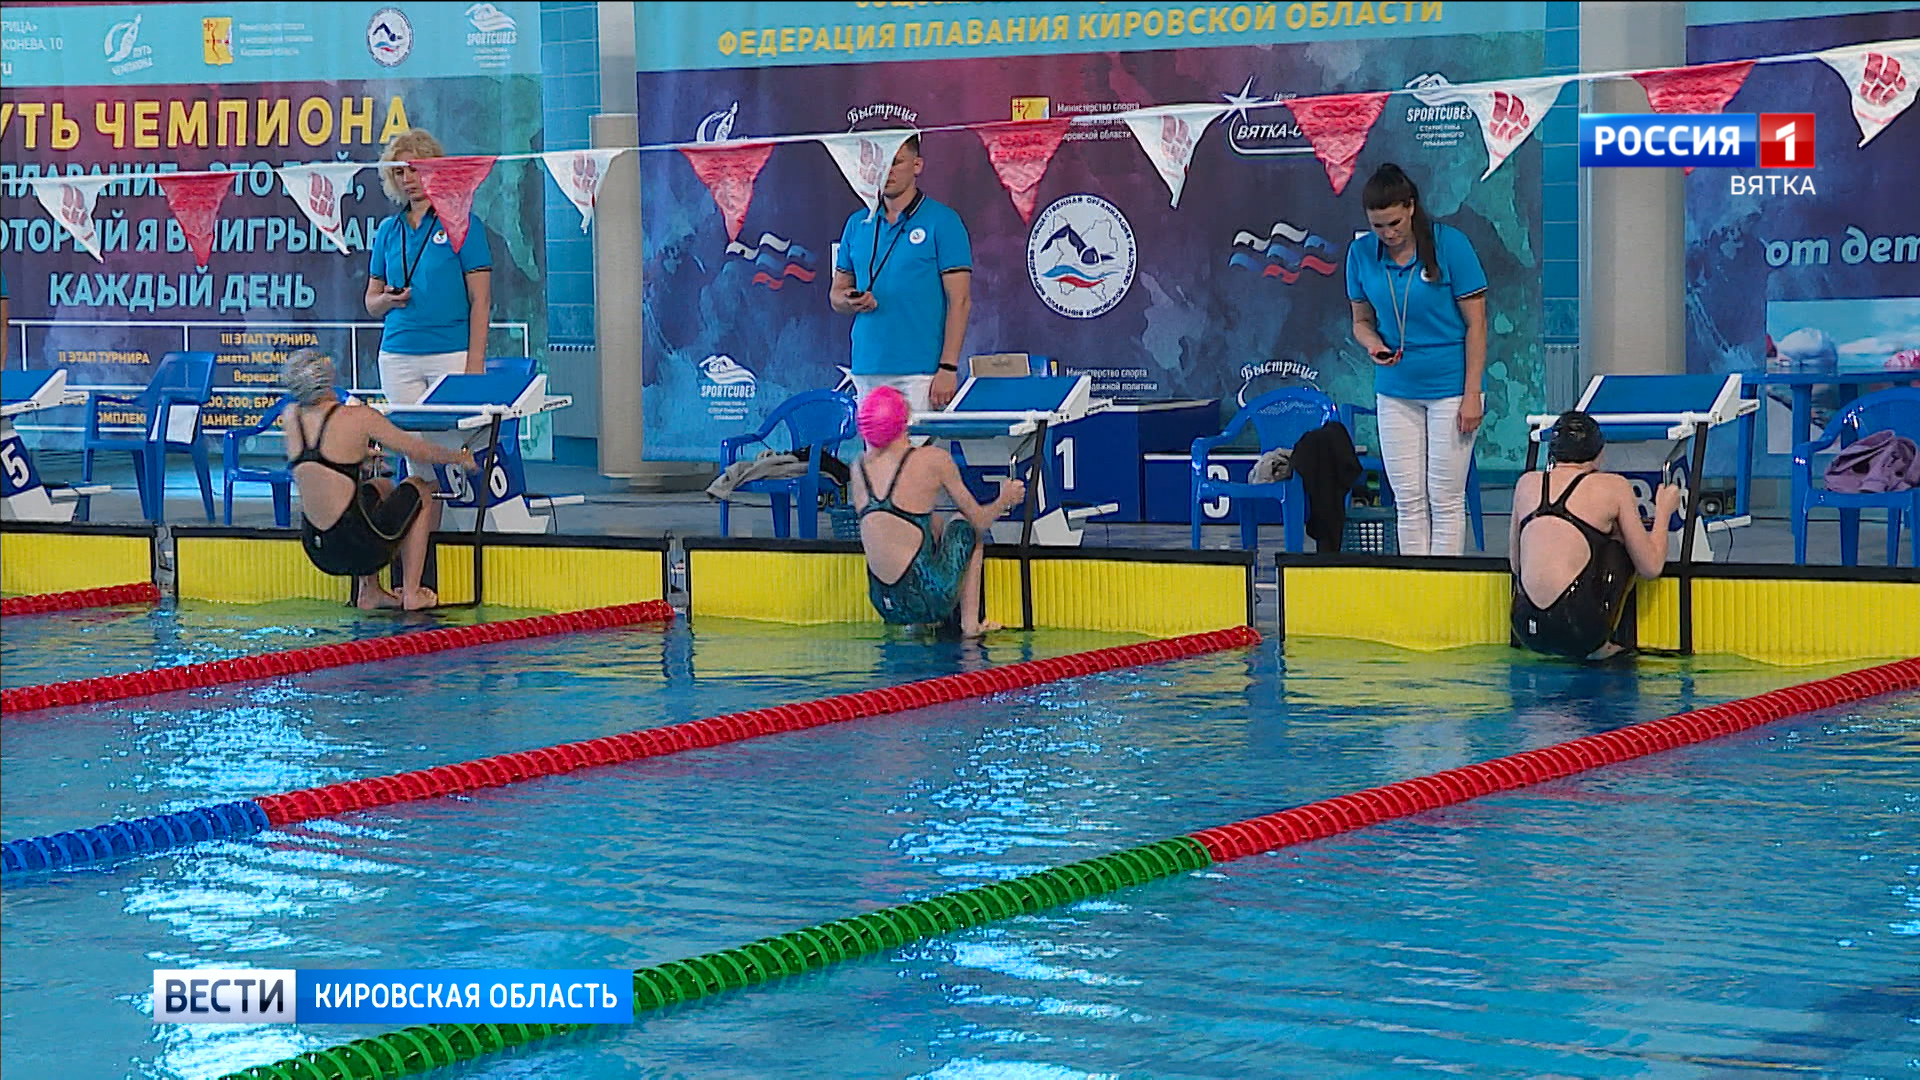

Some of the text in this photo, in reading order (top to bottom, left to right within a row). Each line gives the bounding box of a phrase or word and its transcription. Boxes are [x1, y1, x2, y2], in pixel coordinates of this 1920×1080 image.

[717, 2, 1443, 58] ФЕДЕРАЦИЯ ПЛАВАНИЯ КИРОВСКОЙ ОБЛАСТИ
[49, 37, 64, 51] 10
[847, 103, 918, 124] Быстрица
[1056, 103, 1112, 115] Министерство
[1406, 105, 1473, 122] SPORTCUBES
[95, 95, 411, 149] ЧЕМПИОНА
[135, 219, 159, 252] Я
[1765, 239, 1829, 267] от
[50, 265, 316, 314] КАЖДЫЙ ДЕНЬ
[234, 333, 263, 345] ЭТАП
[265, 333, 319, 346] ТУРНИРА
[68, 351, 96, 364] ЭТАП
[99, 351, 150, 364] ТУРНИРА
[251, 351, 289, 364] МСМК
[1121, 368, 1149, 380] спорта
[1240, 361, 1319, 381] Быстрица
[1121, 382, 1159, 392] политики
[1, 443, 30, 489] 5
[1056, 437, 1075, 490] 1
